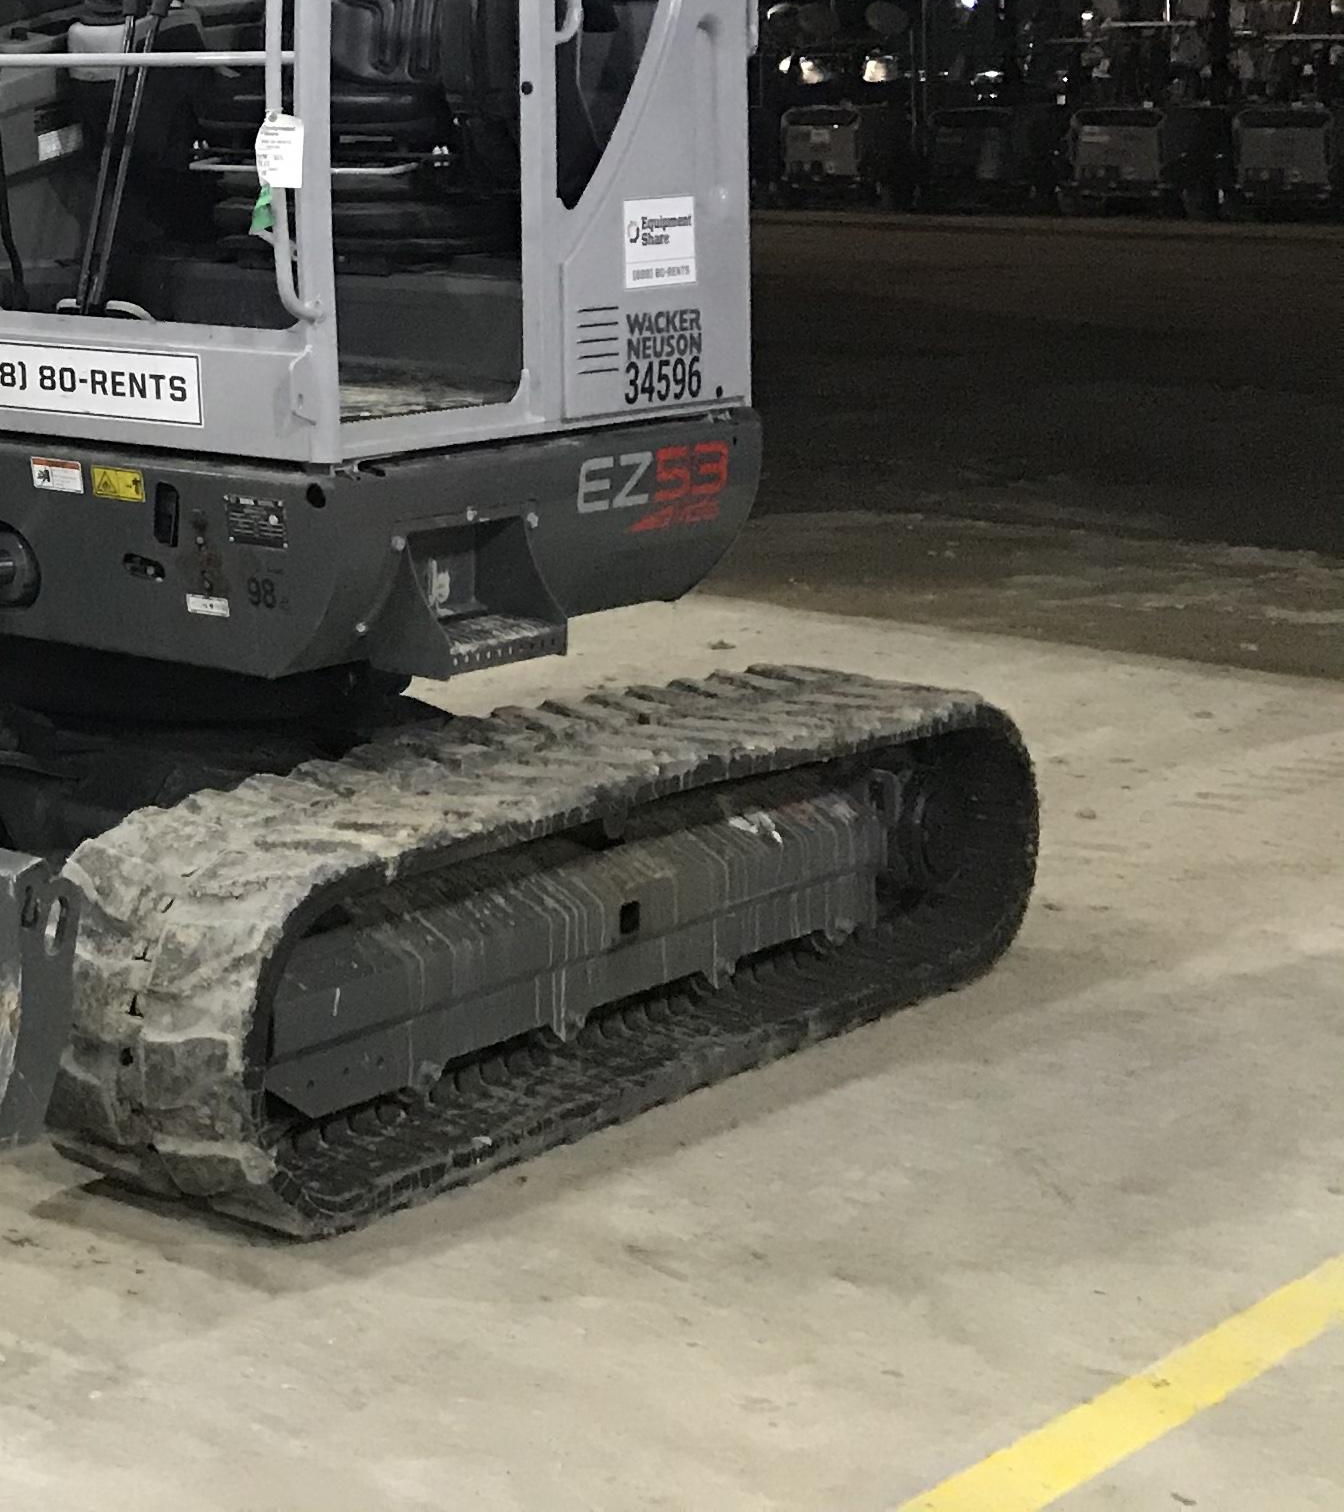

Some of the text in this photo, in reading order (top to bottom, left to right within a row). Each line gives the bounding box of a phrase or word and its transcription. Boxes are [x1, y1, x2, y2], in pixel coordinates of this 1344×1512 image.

[640, 213, 692, 232] Equipment
[641, 231, 670, 246] Share
[625, 307, 702, 336] WACKER
[626, 331, 702, 361] NEUSON
[38, 364, 188, 403] 80-RENTS
[624, 355, 702, 405] 34596
[577, 441, 729, 514] EZ53
[247, 576, 277, 609] 98
